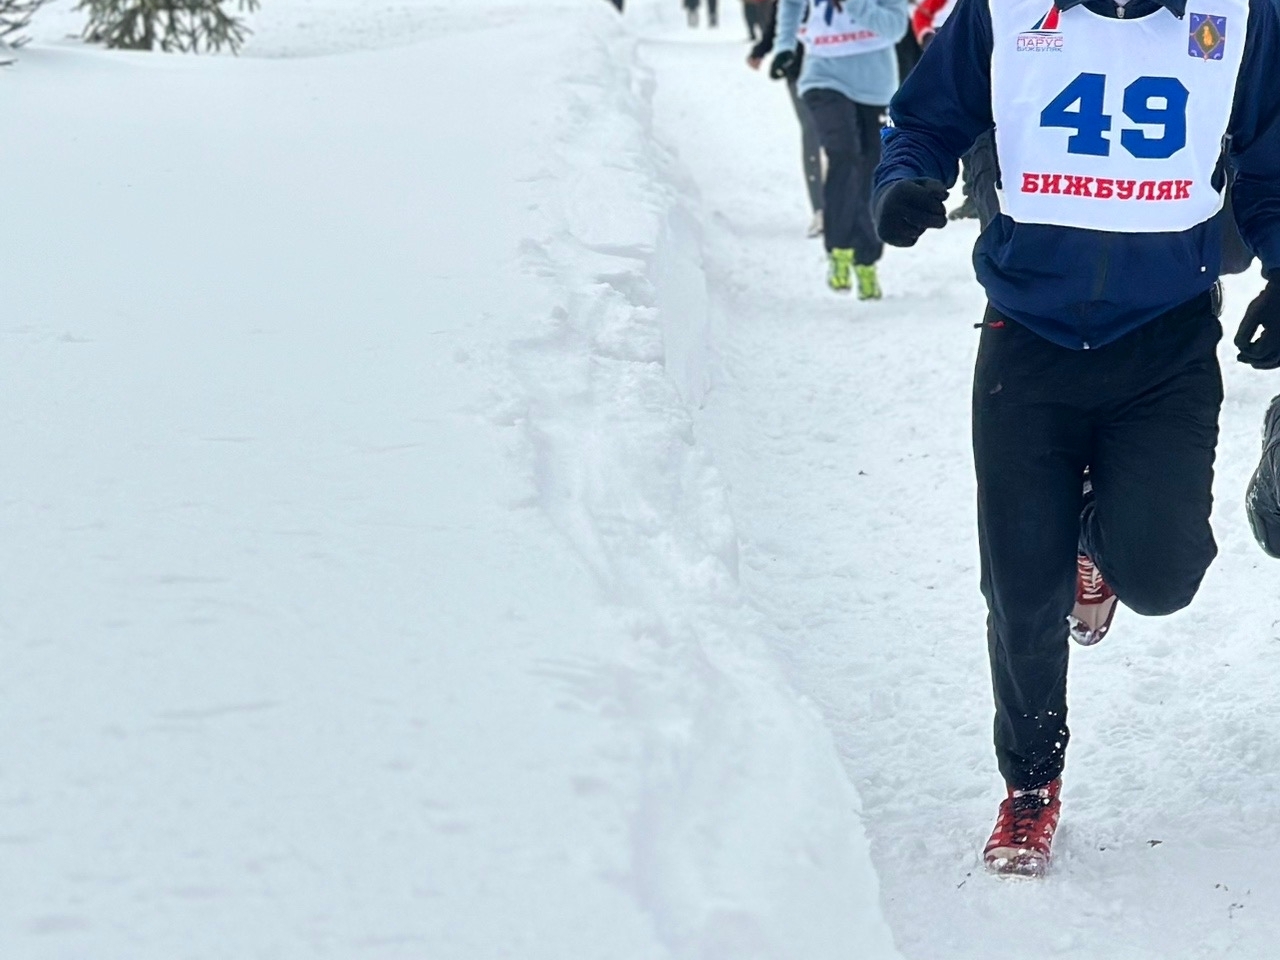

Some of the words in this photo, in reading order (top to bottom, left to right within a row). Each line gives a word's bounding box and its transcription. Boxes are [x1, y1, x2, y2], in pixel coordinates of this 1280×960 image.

[1017, 38, 1063, 47] ПАРУС
[1040, 72, 1190, 159] 49
[1020, 172, 1193, 200] БИЖБУЛЯК
